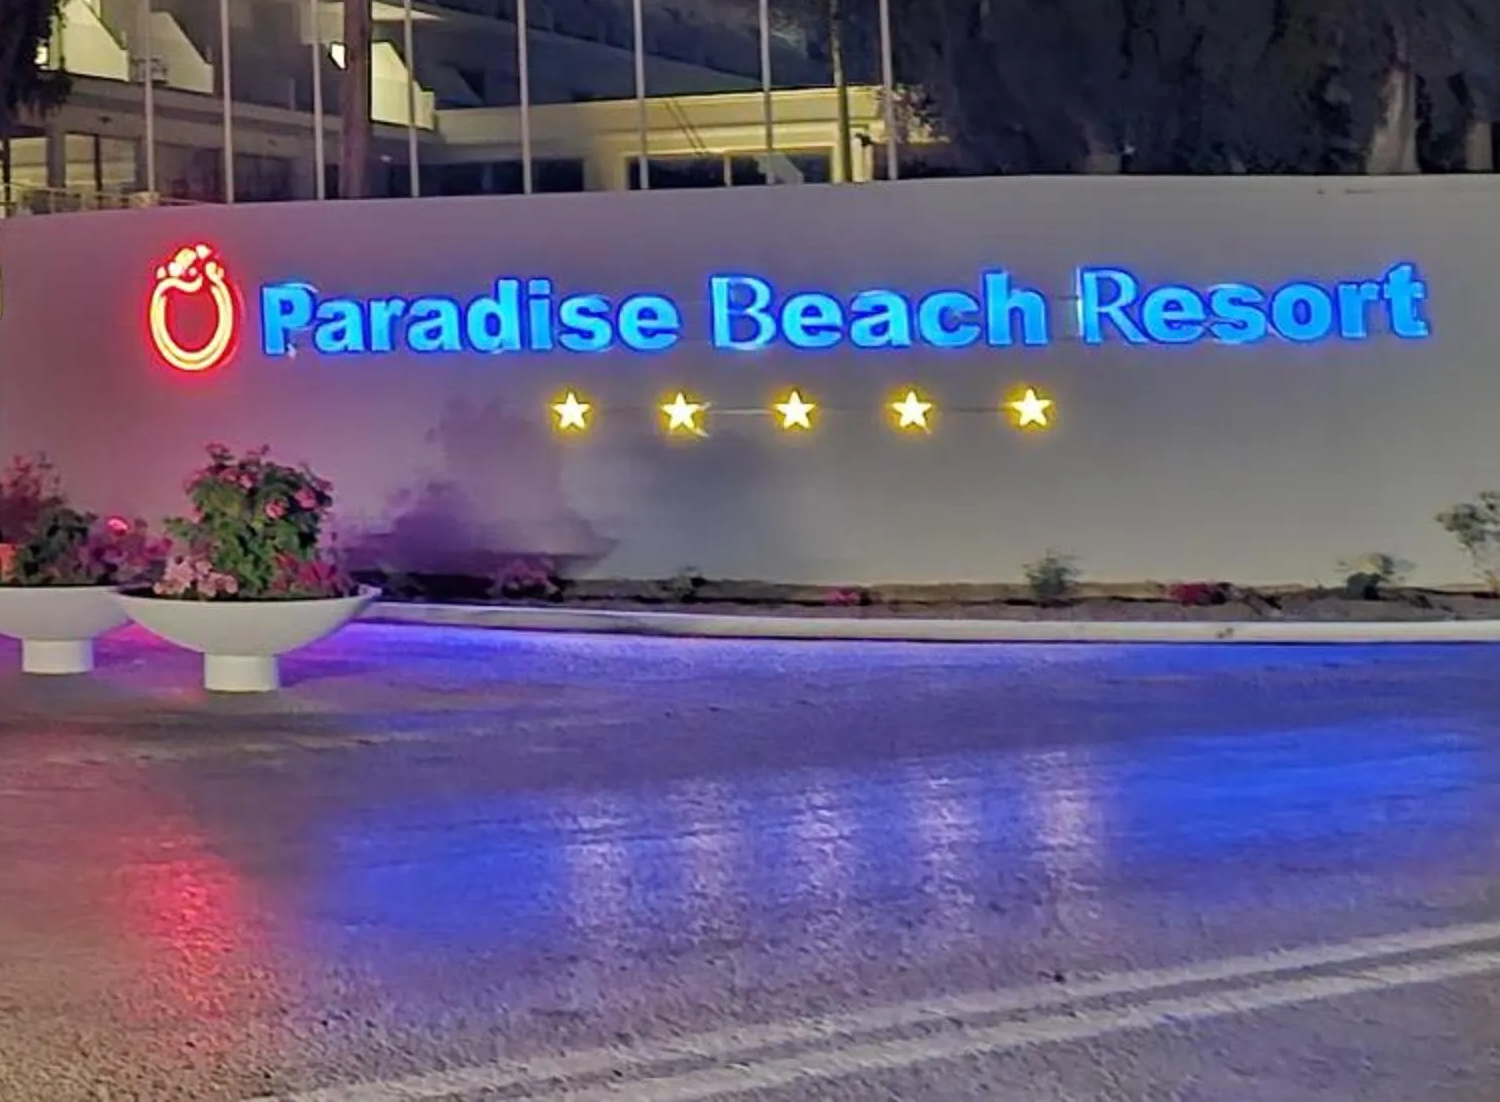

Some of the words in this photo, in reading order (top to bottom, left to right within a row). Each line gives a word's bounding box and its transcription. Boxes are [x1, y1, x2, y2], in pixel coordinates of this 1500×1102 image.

[259, 277, 680, 356] Paradise
[708, 268, 1049, 351] Beach
[1076, 262, 1430, 346] Resort
